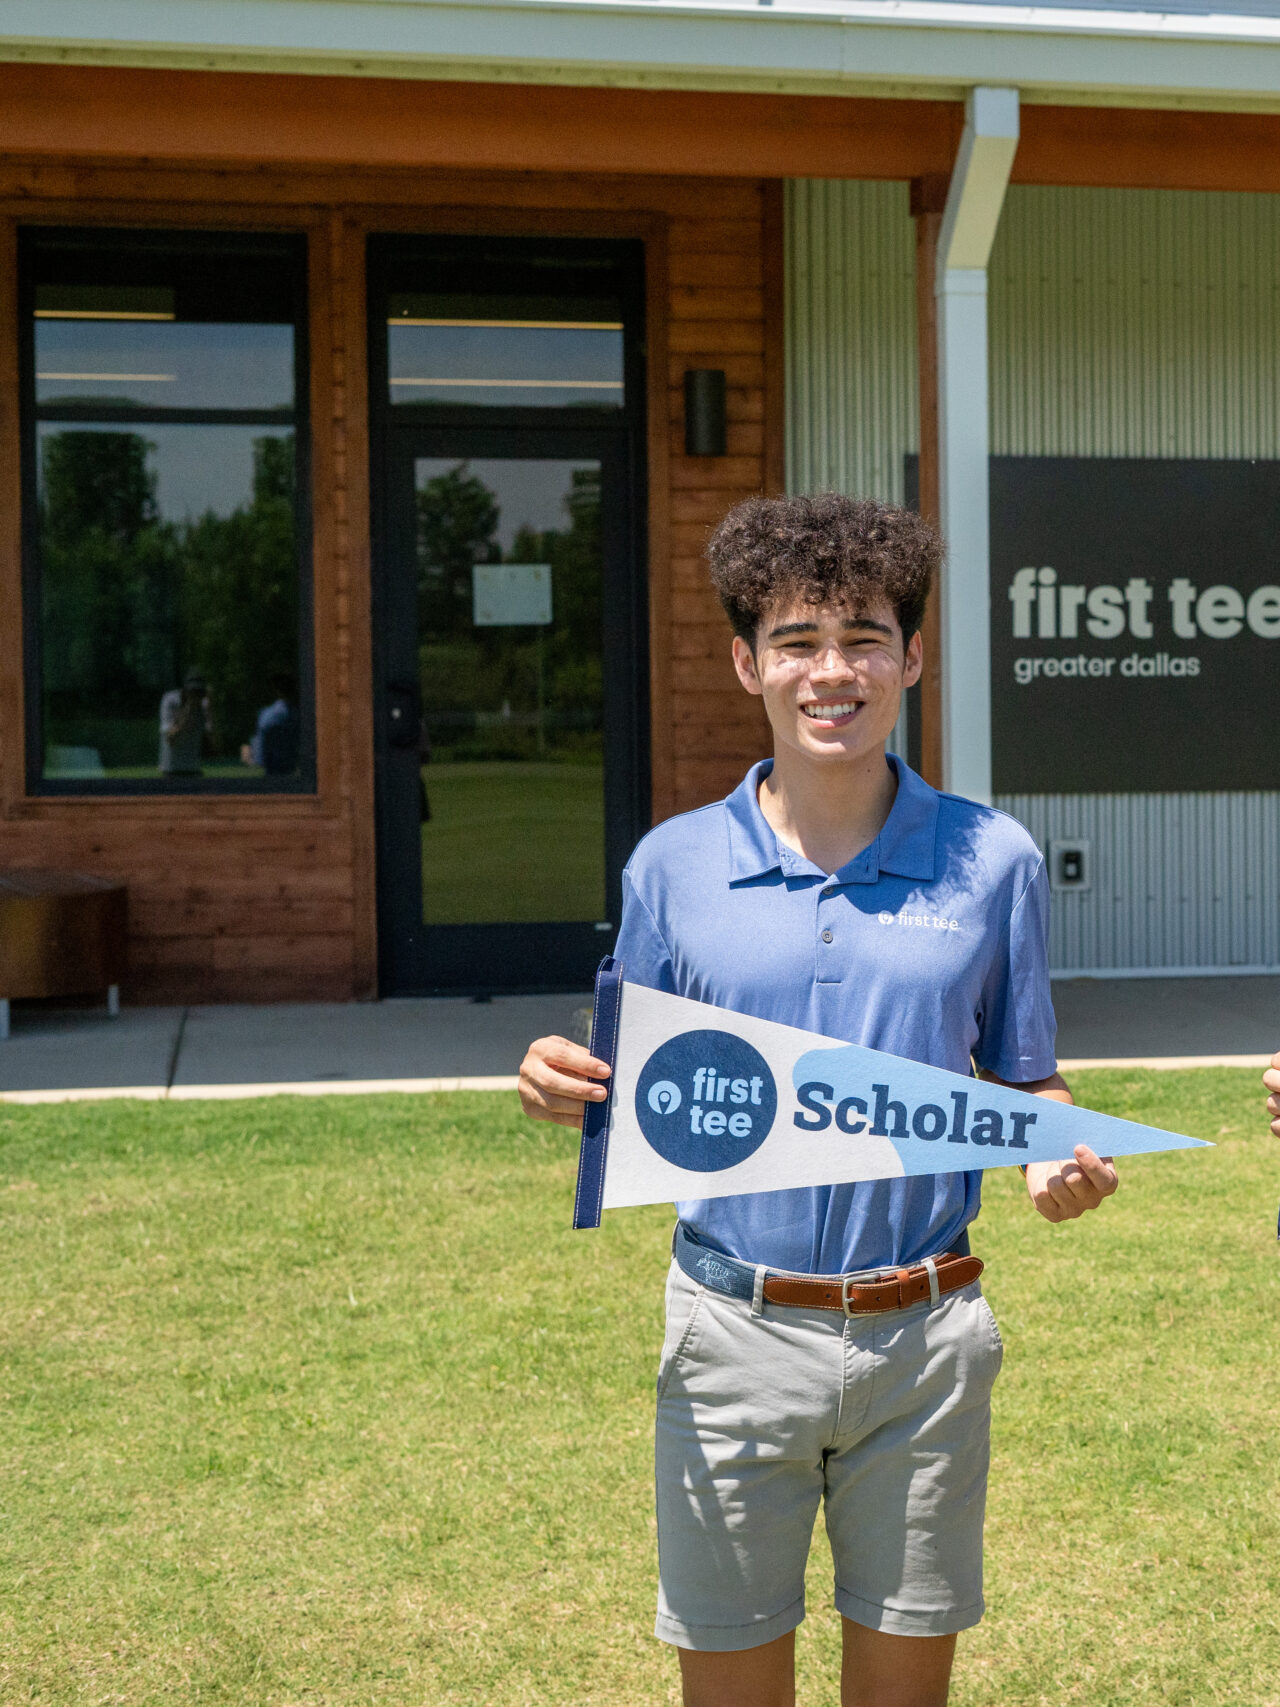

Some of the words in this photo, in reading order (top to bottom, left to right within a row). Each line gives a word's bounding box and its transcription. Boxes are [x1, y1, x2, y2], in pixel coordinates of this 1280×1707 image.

[1008, 566, 1154, 639] first
[1014, 655, 1116, 685] greater
[1120, 653, 1201, 677] dallas
[898, 911, 930, 927] first
[932, 915, 959, 930] tee
[692, 1067, 764, 1105] first
[690, 1105, 753, 1138] tee
[793, 1081, 1038, 1149] Scholar
